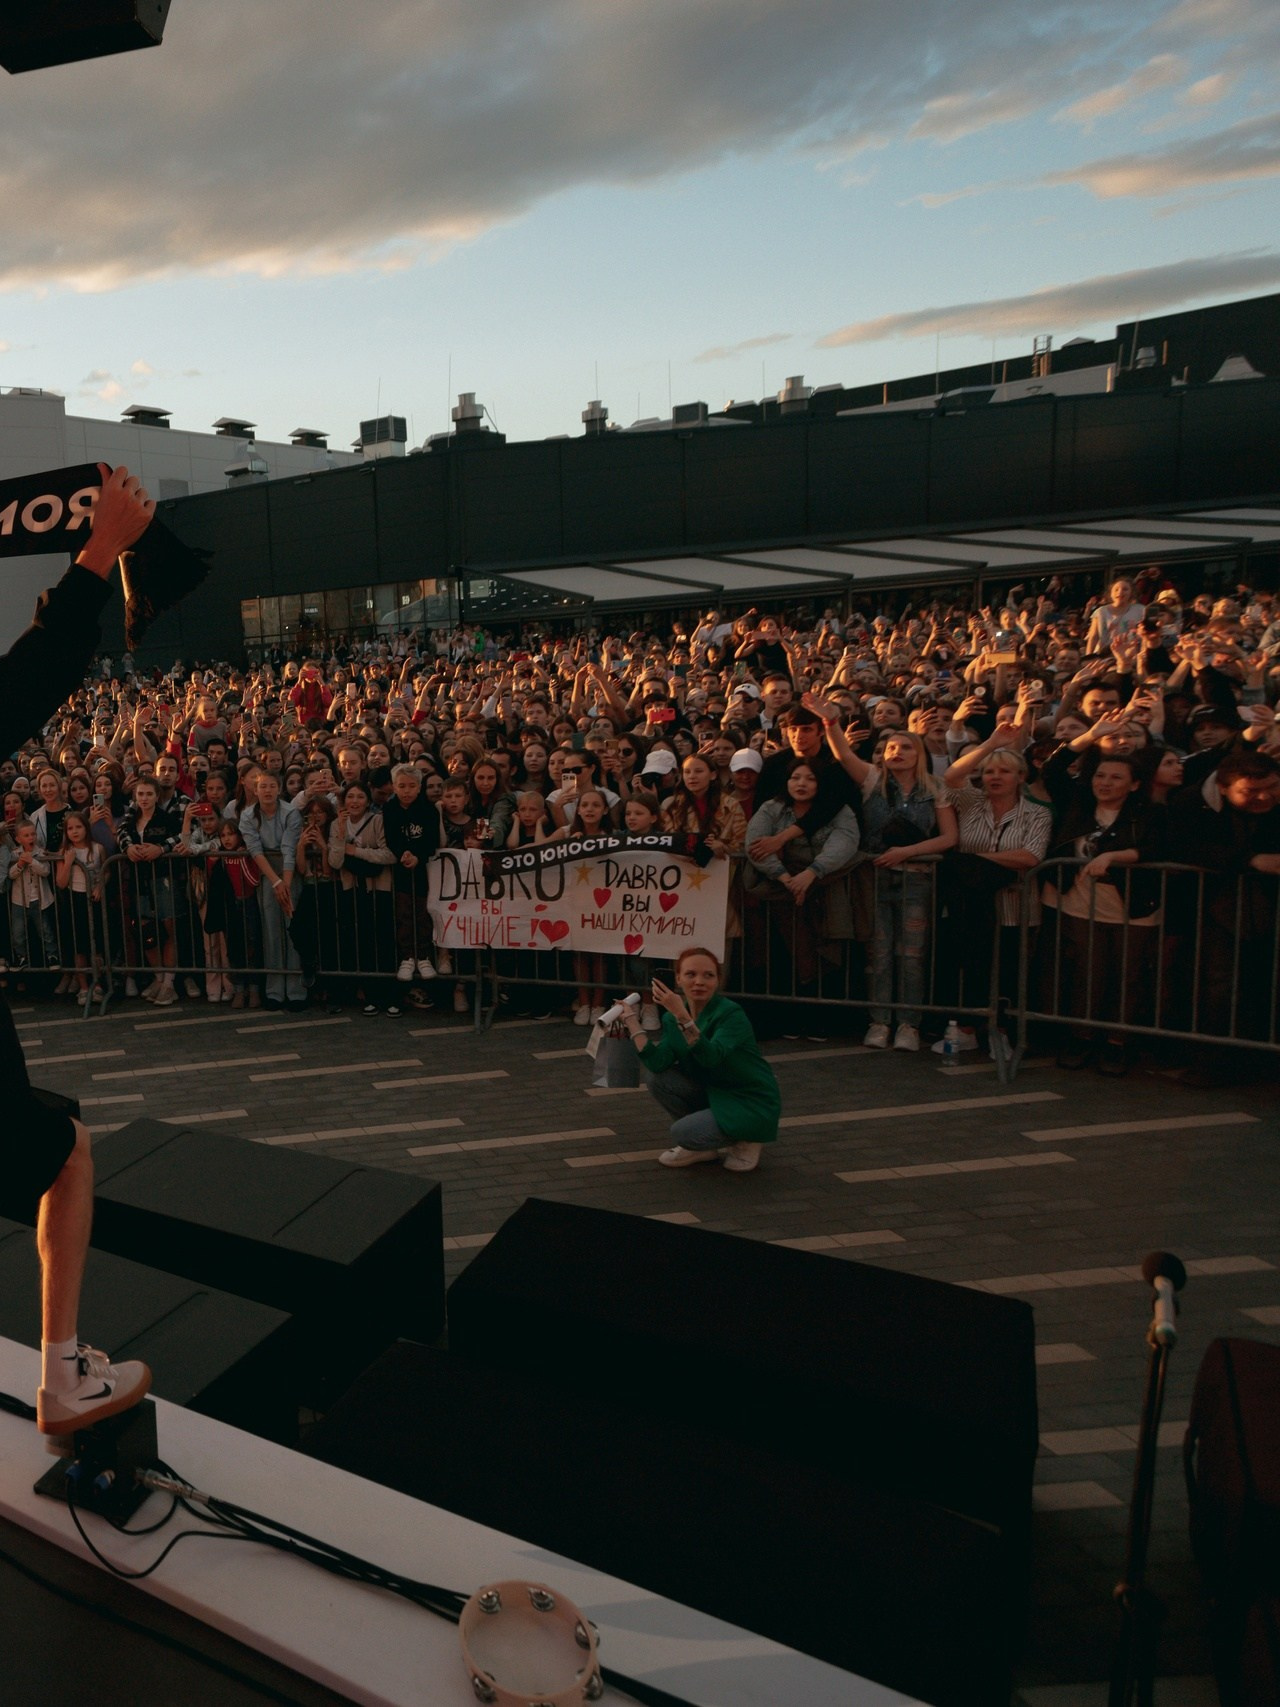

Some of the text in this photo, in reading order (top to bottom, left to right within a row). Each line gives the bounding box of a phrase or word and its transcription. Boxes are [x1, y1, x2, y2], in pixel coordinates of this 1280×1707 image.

[501, 835, 673, 870] ЭТО ЮНОСТЬ МОЯ
[597, 858, 681, 890] DABRO
[481, 899, 503, 915] ВЫ
[622, 893, 650, 912] ВЫ
[581, 912, 696, 936] НАШИ КУМИРЫ
